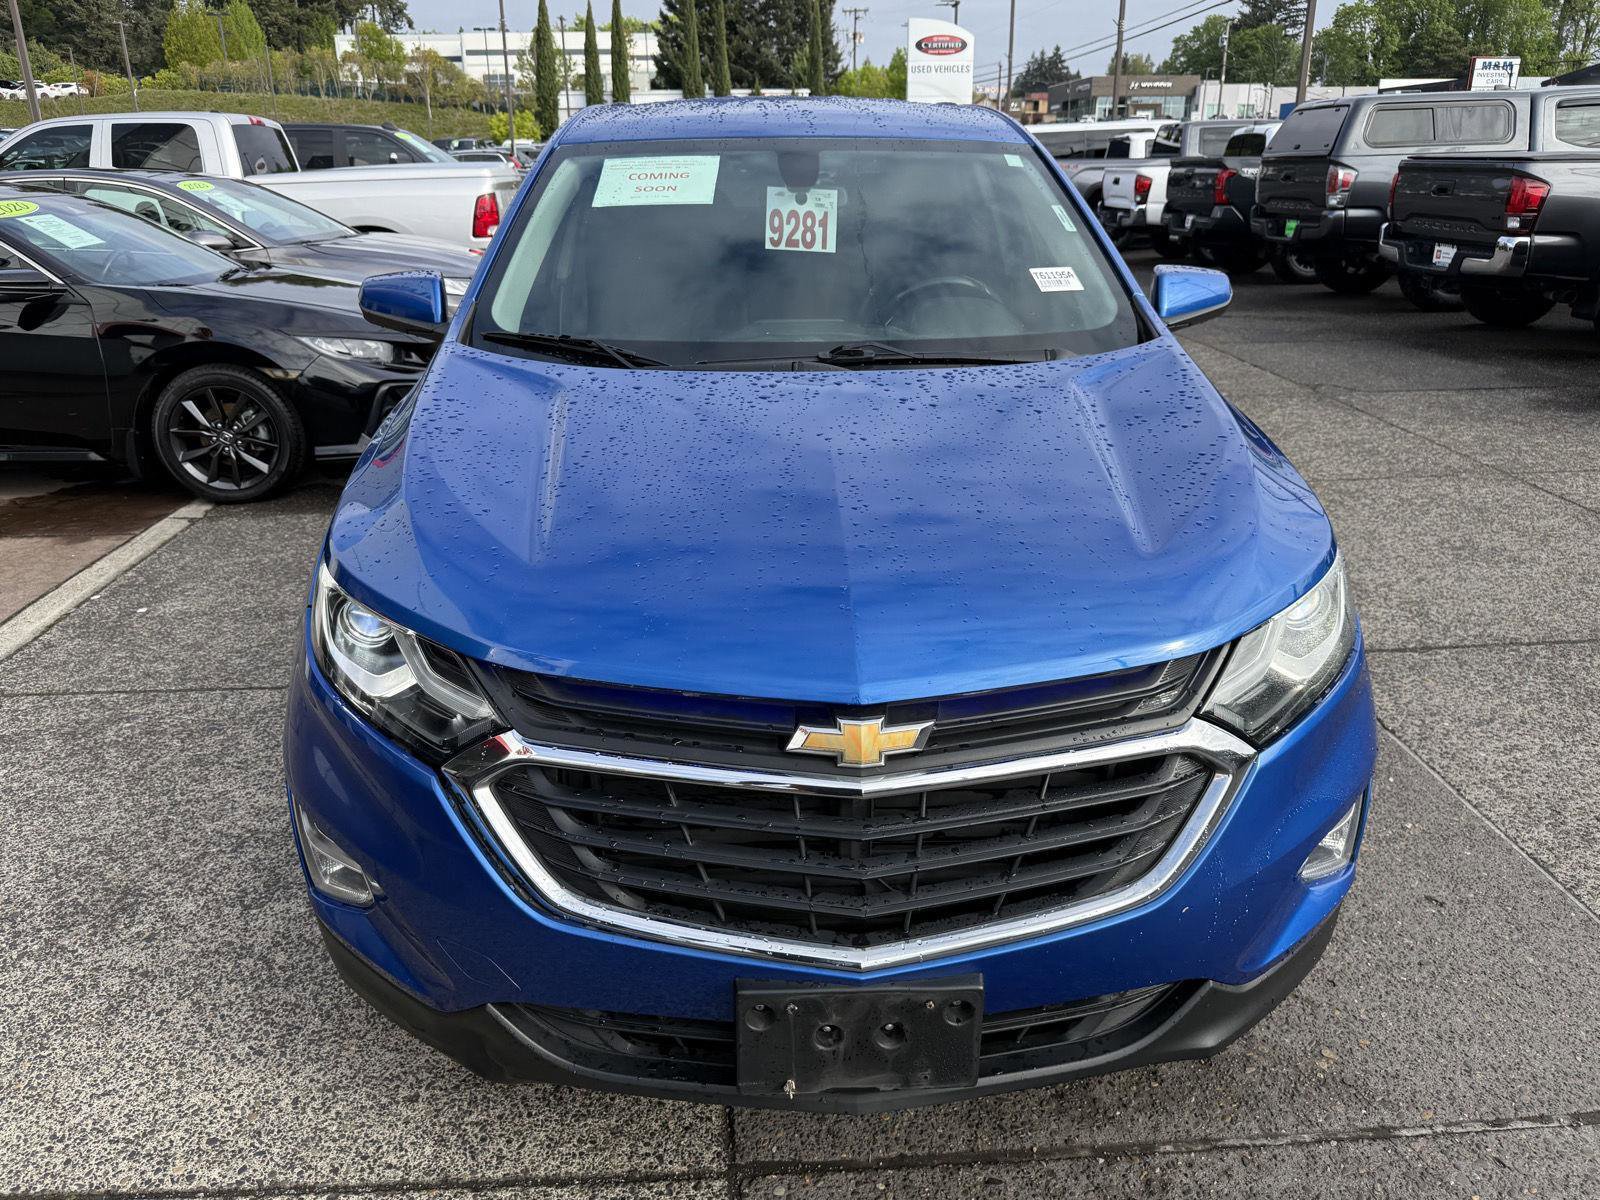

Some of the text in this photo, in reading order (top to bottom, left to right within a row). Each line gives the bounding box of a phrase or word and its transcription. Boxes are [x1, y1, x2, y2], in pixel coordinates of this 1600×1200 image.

[911, 64, 970, 74] USED VEHICLES
[1481, 61, 1512, 70] M&M
[628, 172, 690, 181] COMING
[634, 185, 678, 193] SOON
[0, 202, 31, 216] 020
[769, 208, 829, 250] 9281
